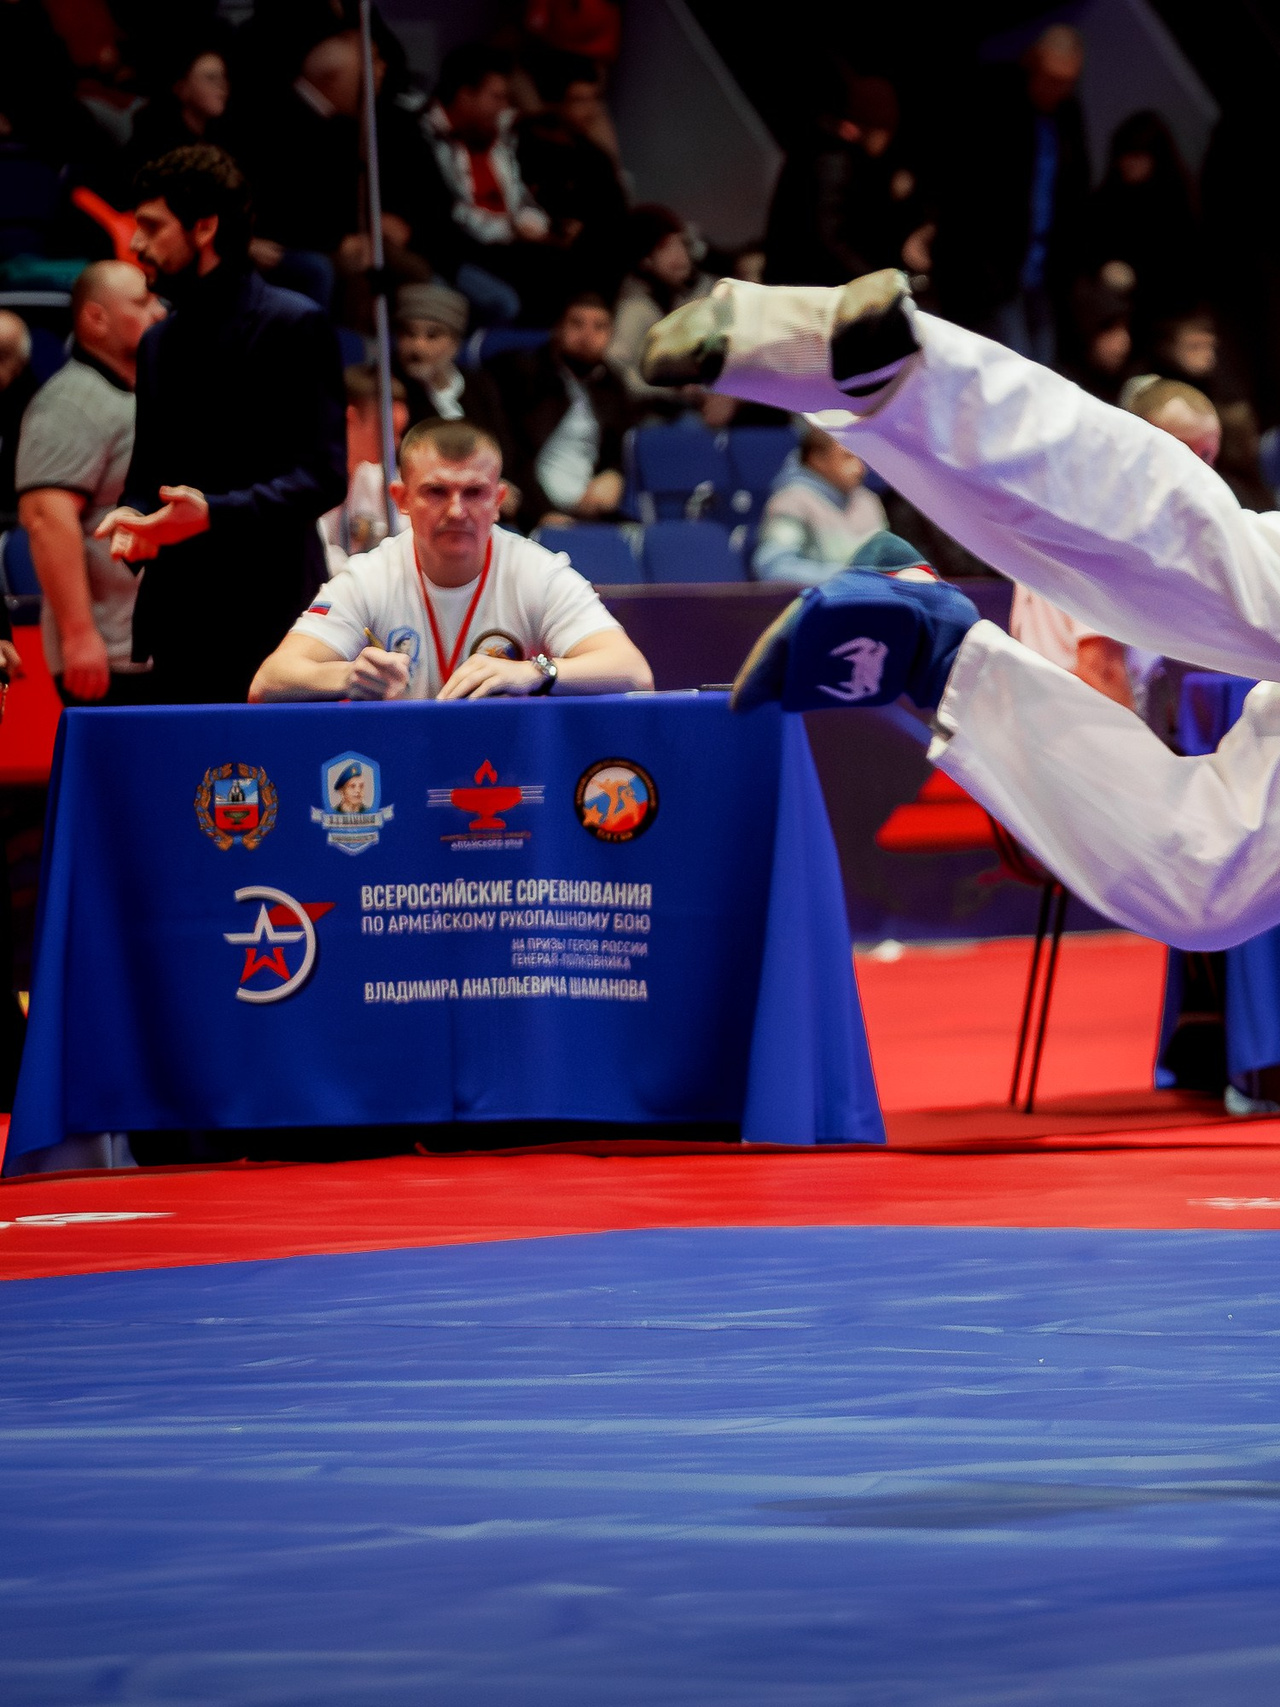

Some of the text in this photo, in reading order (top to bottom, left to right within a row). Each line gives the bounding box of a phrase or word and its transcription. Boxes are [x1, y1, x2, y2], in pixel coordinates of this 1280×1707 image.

[361, 878, 652, 910] ВСЕРОССИЙСКИЕ СОРЕВНОВАНИЯ
[361, 910, 651, 934] ПО АРМЕЙСКОМУ РУКОПАШНОМУ БОЮ
[527, 937, 565, 951] ПРИЗЫ
[364, 976, 648, 1004] ВЛАДИМИРА АНАТОЛЬЕВИЧА ШАМАНОВА
